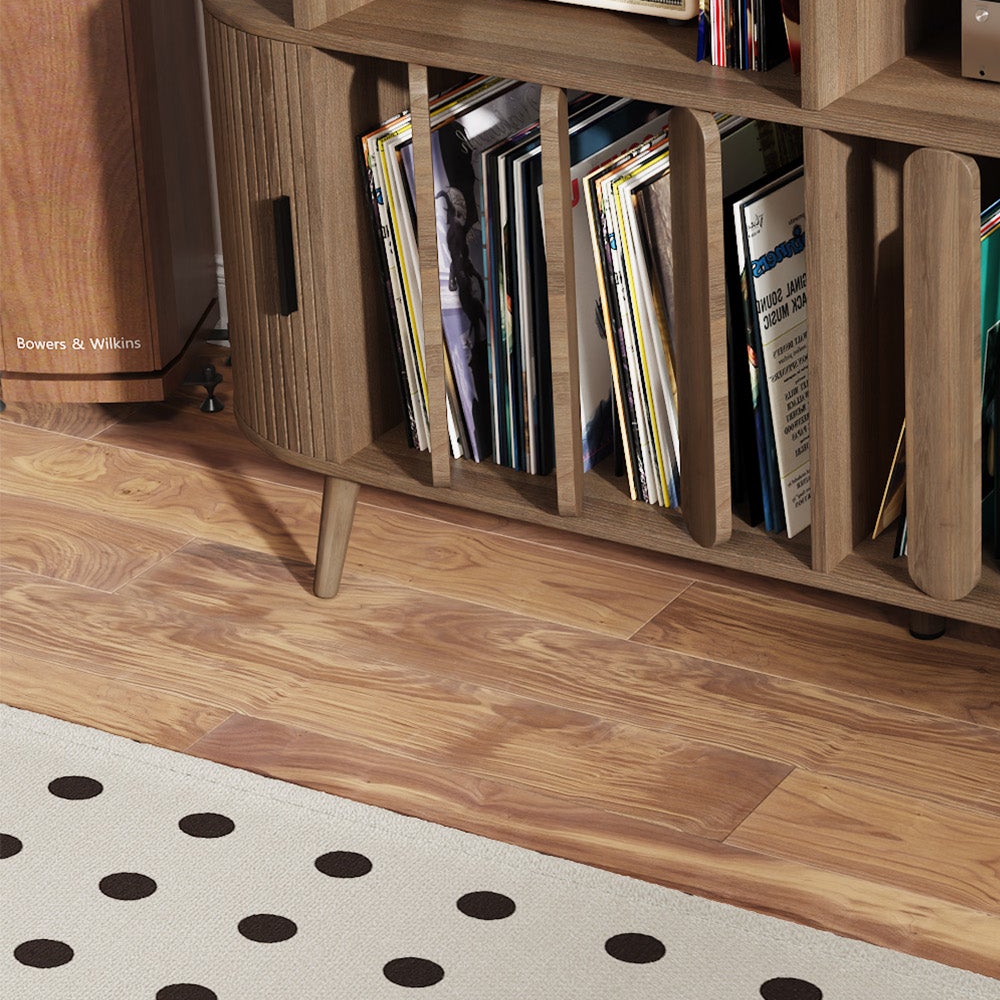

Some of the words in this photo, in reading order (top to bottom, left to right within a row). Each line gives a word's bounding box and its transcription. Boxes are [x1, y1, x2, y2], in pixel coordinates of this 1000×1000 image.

[16, 337, 67, 349] Bowers
[72, 338, 85, 350] &
[89, 336, 141, 349] Wilkins
